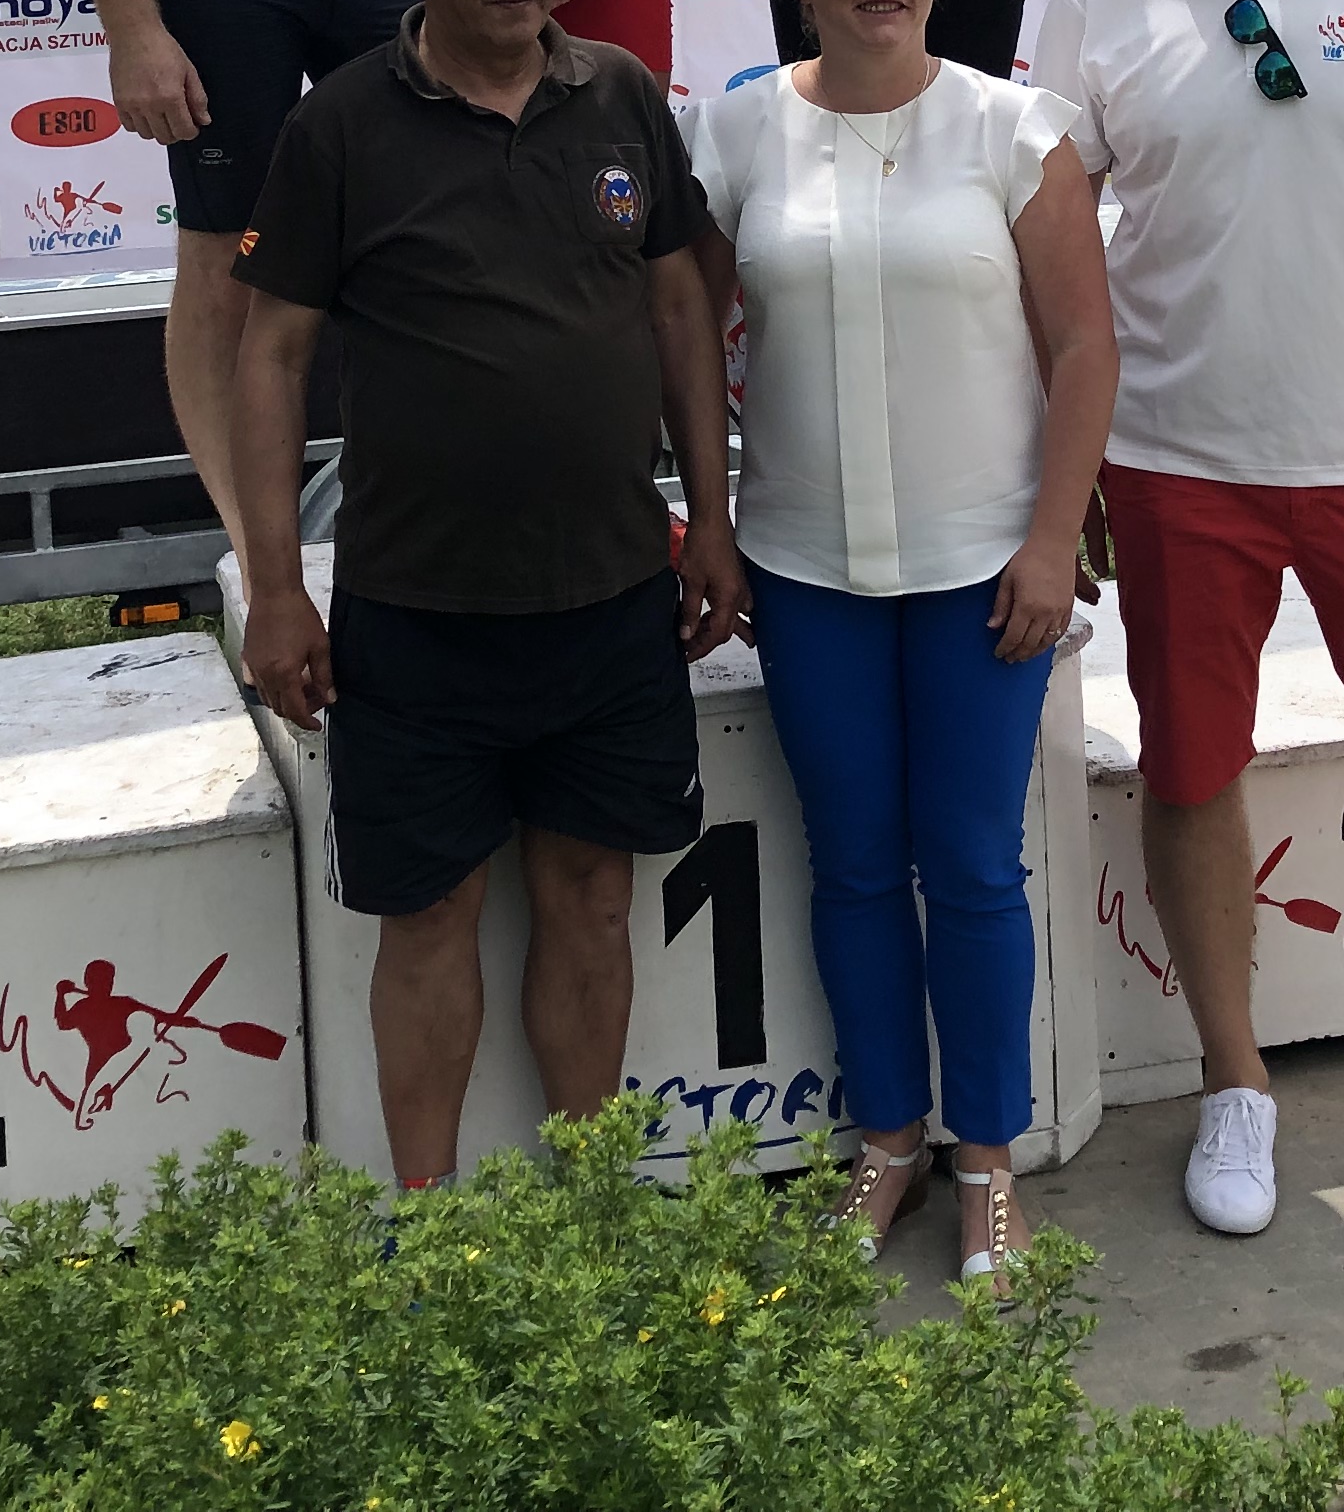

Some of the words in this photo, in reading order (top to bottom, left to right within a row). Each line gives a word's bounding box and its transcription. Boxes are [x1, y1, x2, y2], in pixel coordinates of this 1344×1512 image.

[48, 32, 109, 48] SZTUM
[38, 110, 97, 135] ESCO
[662, 820, 767, 1069] 1
